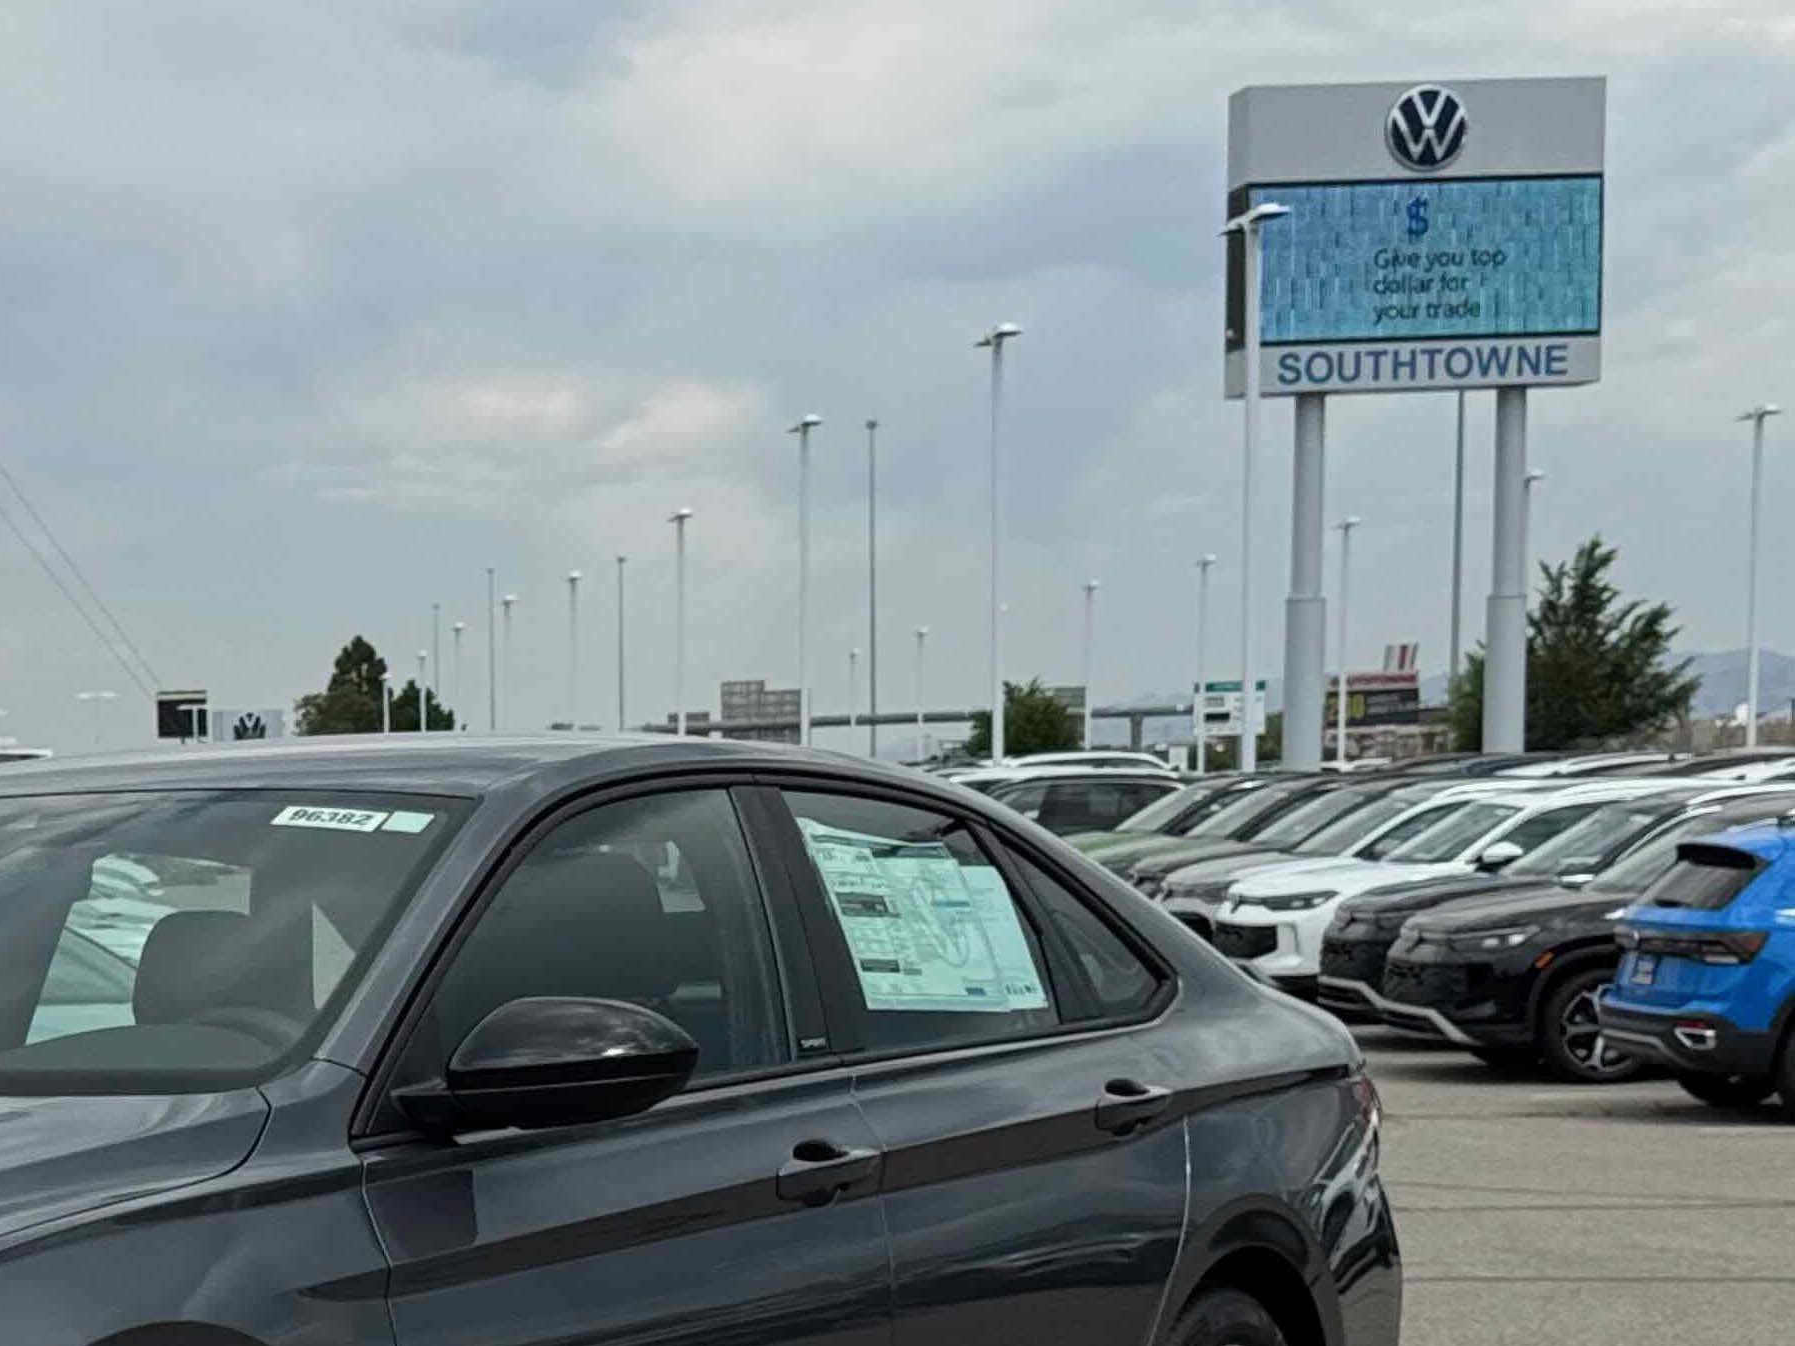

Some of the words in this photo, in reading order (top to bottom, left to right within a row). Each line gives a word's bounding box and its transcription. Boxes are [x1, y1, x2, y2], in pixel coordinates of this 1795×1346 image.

[1374, 248, 1420, 270] Give
[1426, 251, 1464, 273] you
[1470, 249, 1508, 269] top
[1373, 273, 1434, 295] dollar
[1440, 272, 1469, 292] for
[1373, 303, 1419, 327] your
[1426, 299, 1481, 319] trade
[1278, 344, 1569, 386] SOUTHTOWNE
[289, 809, 373, 825] 96382
